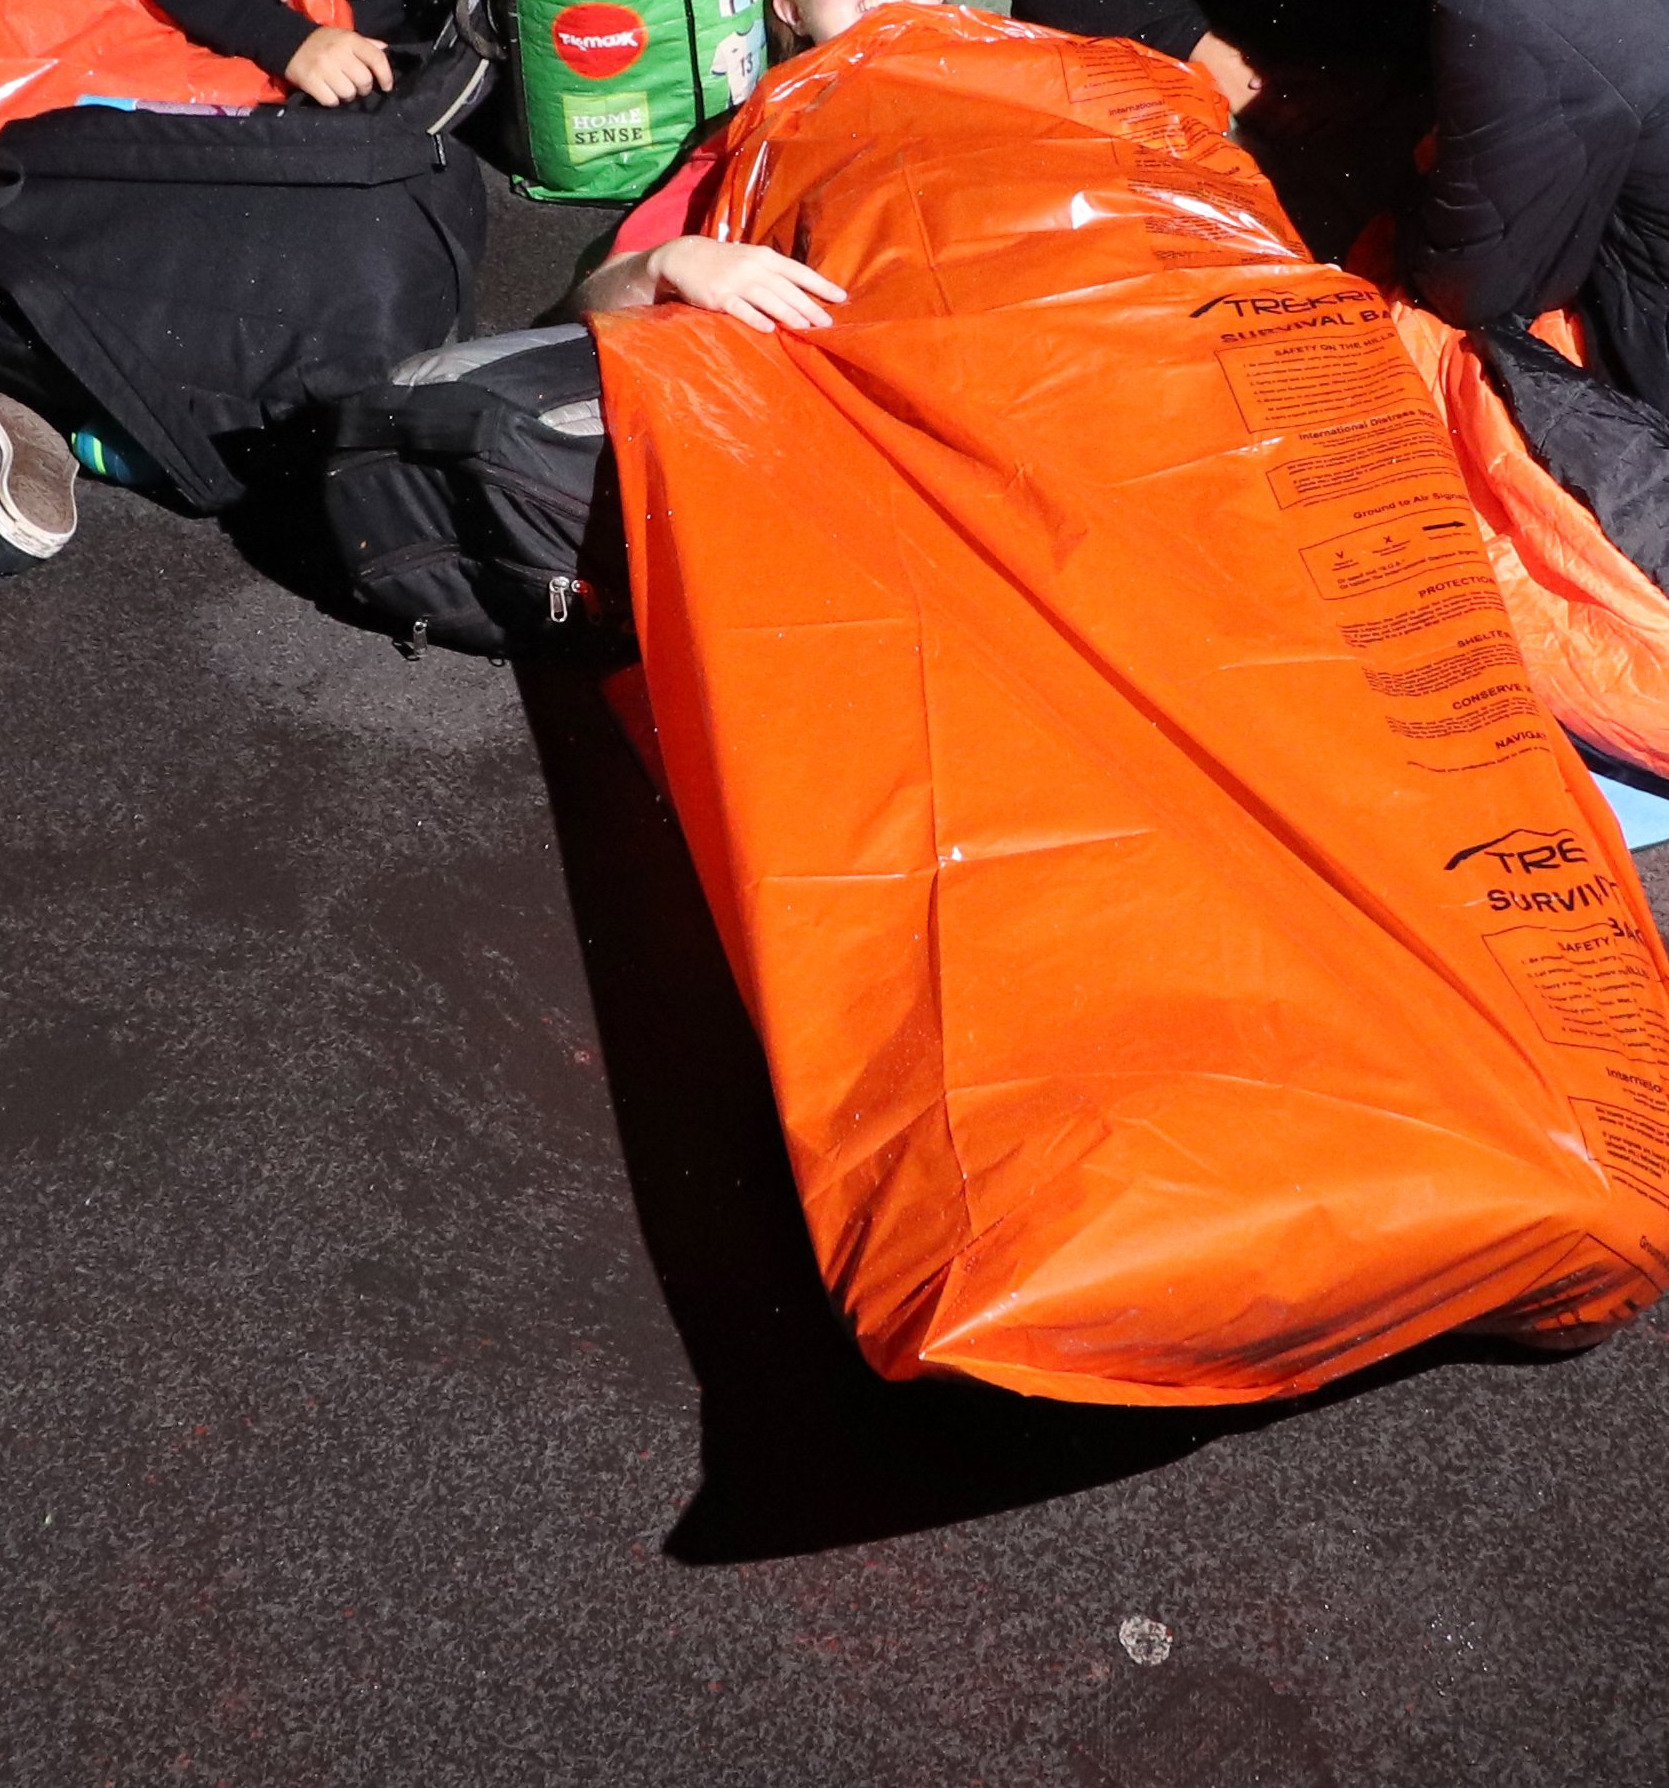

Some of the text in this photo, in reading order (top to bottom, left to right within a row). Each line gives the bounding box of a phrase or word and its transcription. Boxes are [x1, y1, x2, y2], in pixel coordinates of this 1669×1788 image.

[739, 52, 754, 77] 13
[572, 108, 642, 130] HOME
[574, 127, 643, 145] SENSE
[1219, 313, 1355, 344] SURVIVAL
[1299, 420, 1369, 441] International
[1370, 410, 1416, 426] Distress
[1353, 502, 1396, 519] Ground
[1398, 498, 1411, 507] to
[1412, 494, 1430, 505] Air
[1453, 683, 1522, 710] CONSERVE
